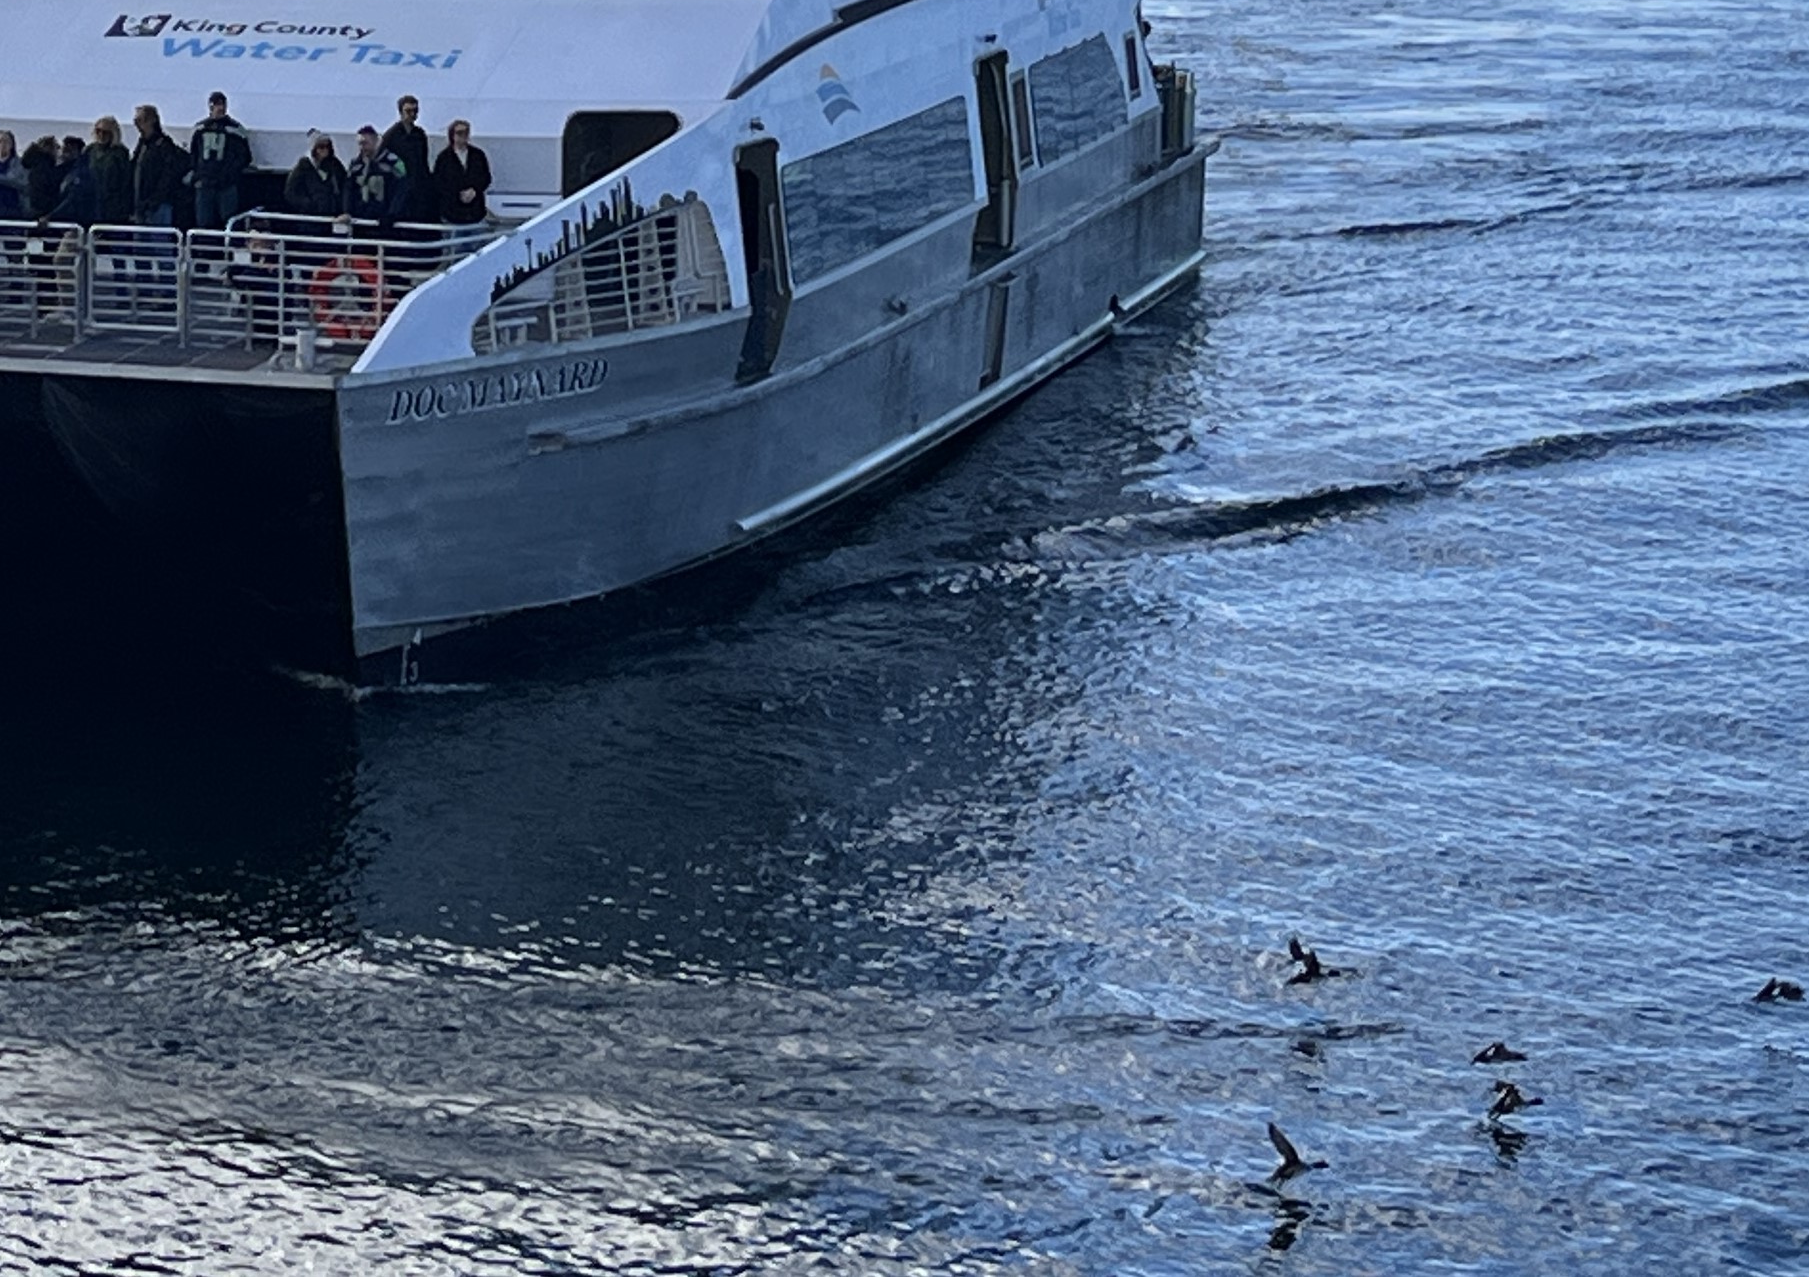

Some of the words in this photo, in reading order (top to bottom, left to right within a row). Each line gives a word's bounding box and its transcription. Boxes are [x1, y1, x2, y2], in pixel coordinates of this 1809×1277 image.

[172, 19, 248, 36] King
[253, 21, 376, 40] County
[163, 38, 338, 61] Water
[347, 43, 463, 69] Taxi
[386, 382, 459, 425] DOC
[458, 358, 609, 415] MAYNARD
